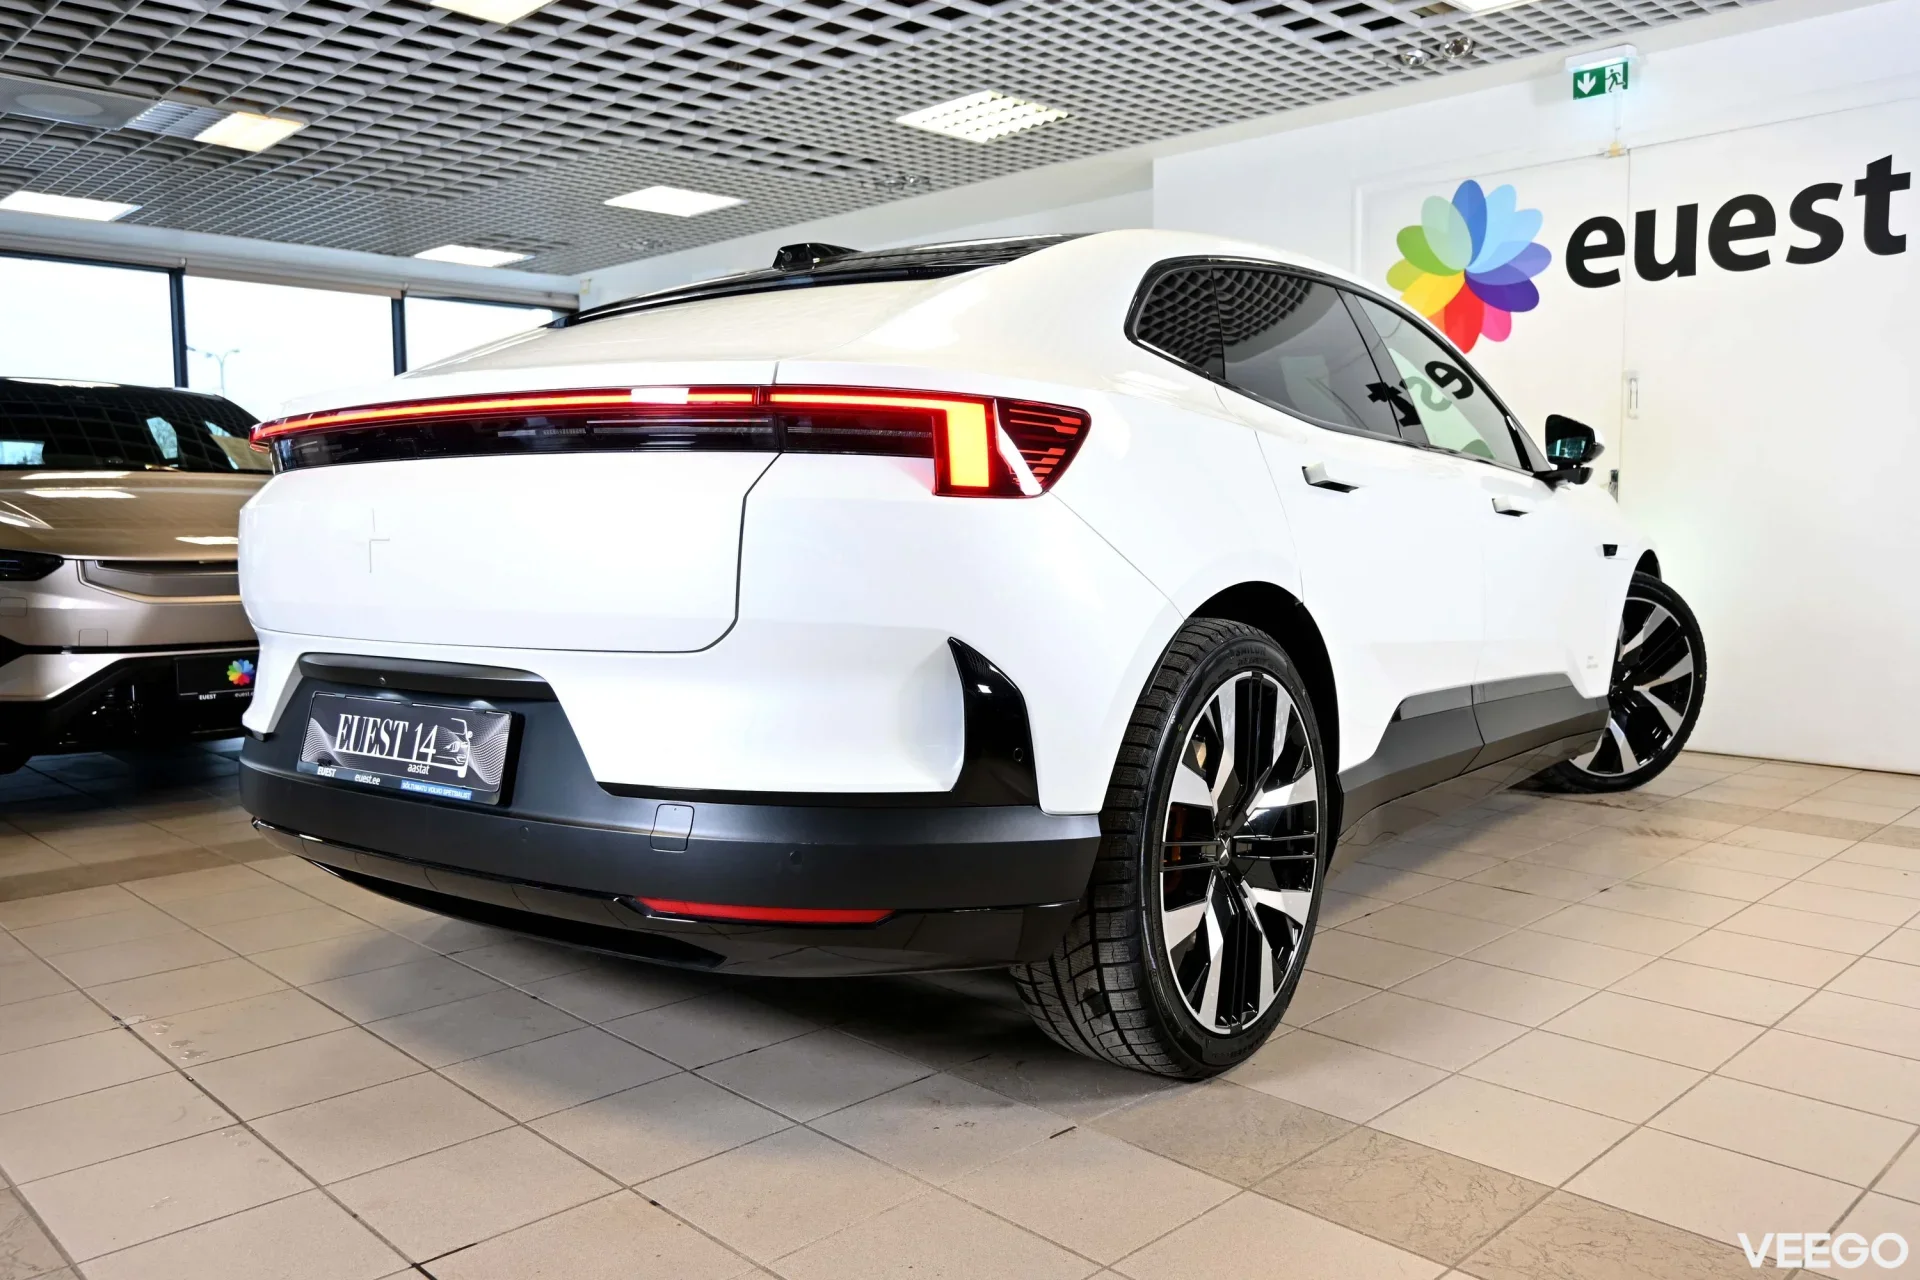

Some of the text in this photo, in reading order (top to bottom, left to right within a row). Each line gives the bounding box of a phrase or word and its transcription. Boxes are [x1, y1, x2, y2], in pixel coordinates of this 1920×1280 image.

[1565, 154, 1911, 288] euest
[333, 713, 438, 764] EUEST 14
[317, 767, 381, 785] EUEST euest.ee
[407, 763, 430, 775] aastat
[428, 786, 443, 795] VOLVO
